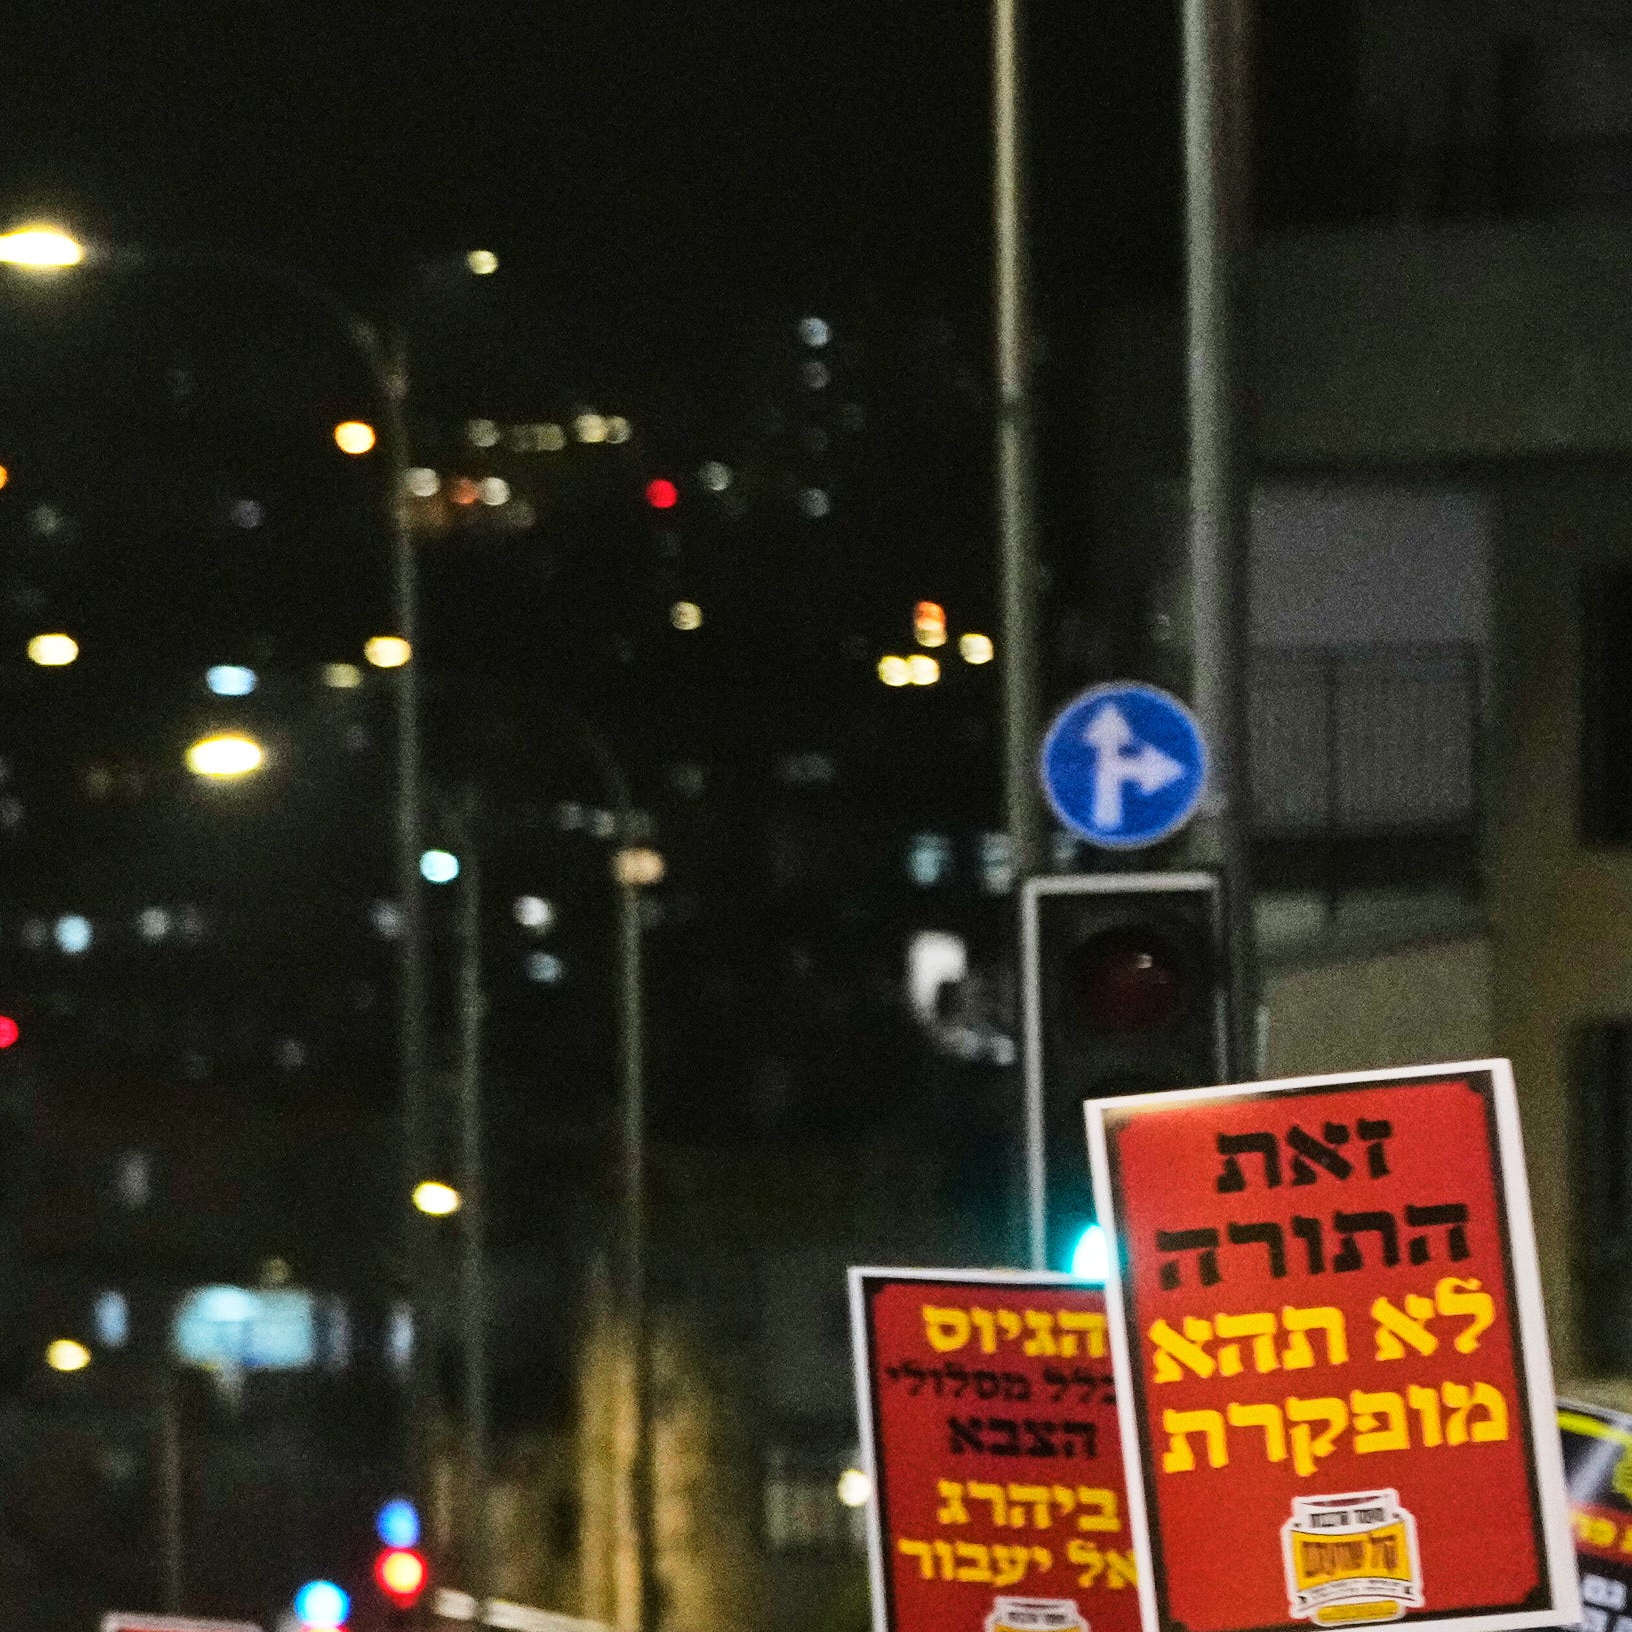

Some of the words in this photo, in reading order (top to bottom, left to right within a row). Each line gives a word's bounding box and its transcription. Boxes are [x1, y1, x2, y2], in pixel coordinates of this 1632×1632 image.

[1216, 1118, 1392, 1193] זאת
[1157, 1203, 1471, 1291] התורה
[922, 1304, 1106, 1358] הגיוס
[1149, 1306, 1349, 1383] תהא
[1372, 1277, 1495, 1361] לא
[885, 1361, 1032, 1400] מסלולי
[1043, 1365, 1116, 1405] כלל
[948, 1416, 1097, 1458] הצבא
[1162, 1382, 1509, 1477] מופקרת
[937, 1479, 1121, 1532] ביהרג
[897, 1537, 1053, 1587] יעבור
[1066, 1539, 1137, 1589] אל
